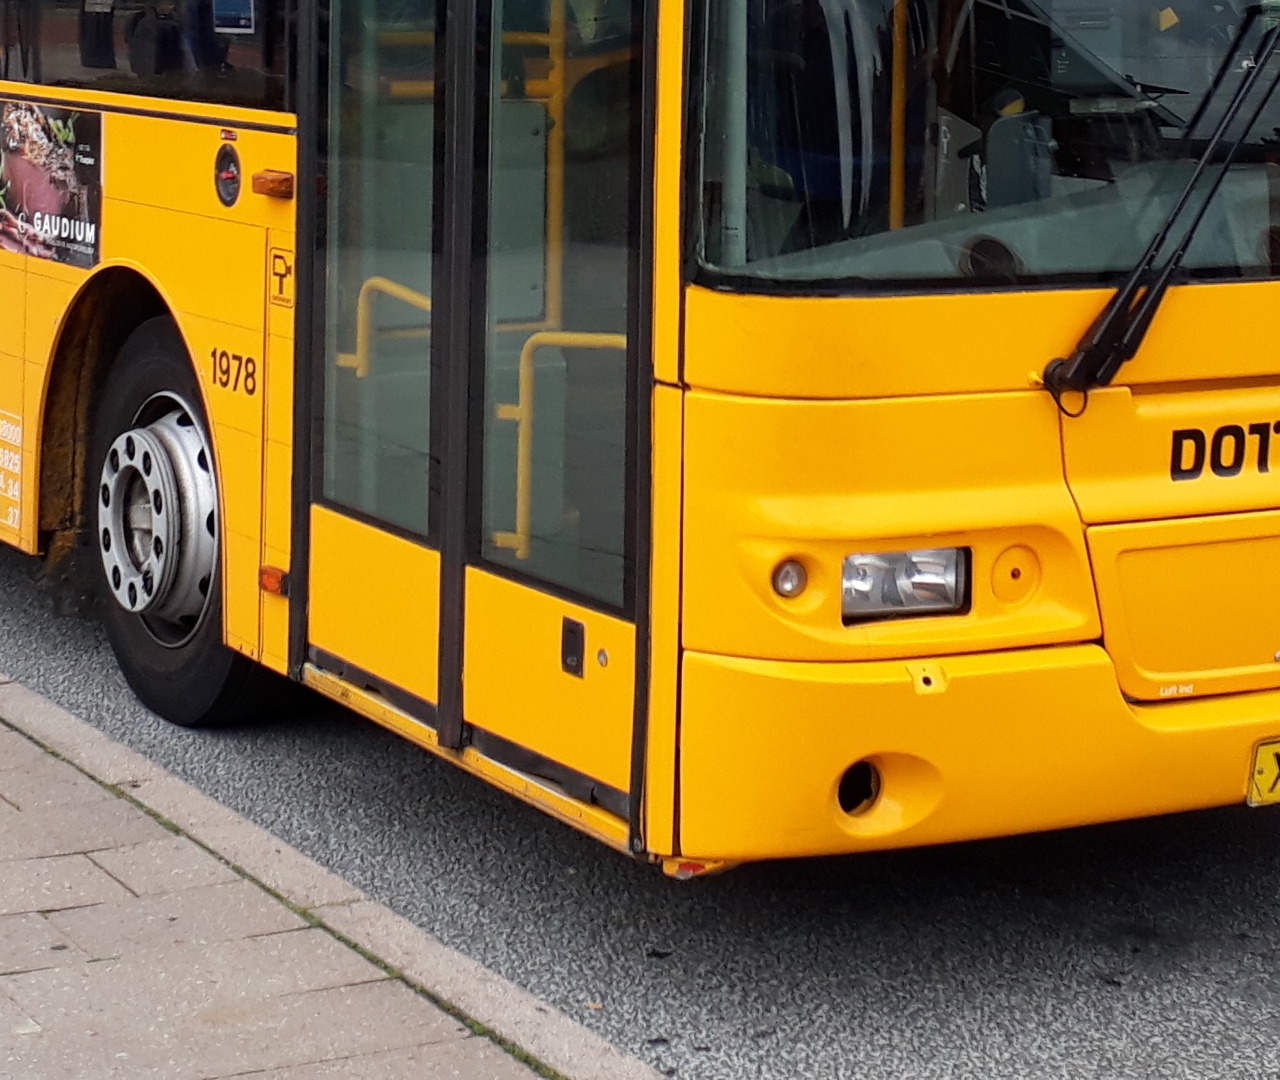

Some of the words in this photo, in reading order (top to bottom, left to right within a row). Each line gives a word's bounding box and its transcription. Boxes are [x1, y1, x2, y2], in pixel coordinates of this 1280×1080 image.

[33, 211, 96, 244] GAUDIUM
[210, 347, 257, 396] 1978
[7, 478, 19, 497] 34
[7, 507, 19, 529] 37
